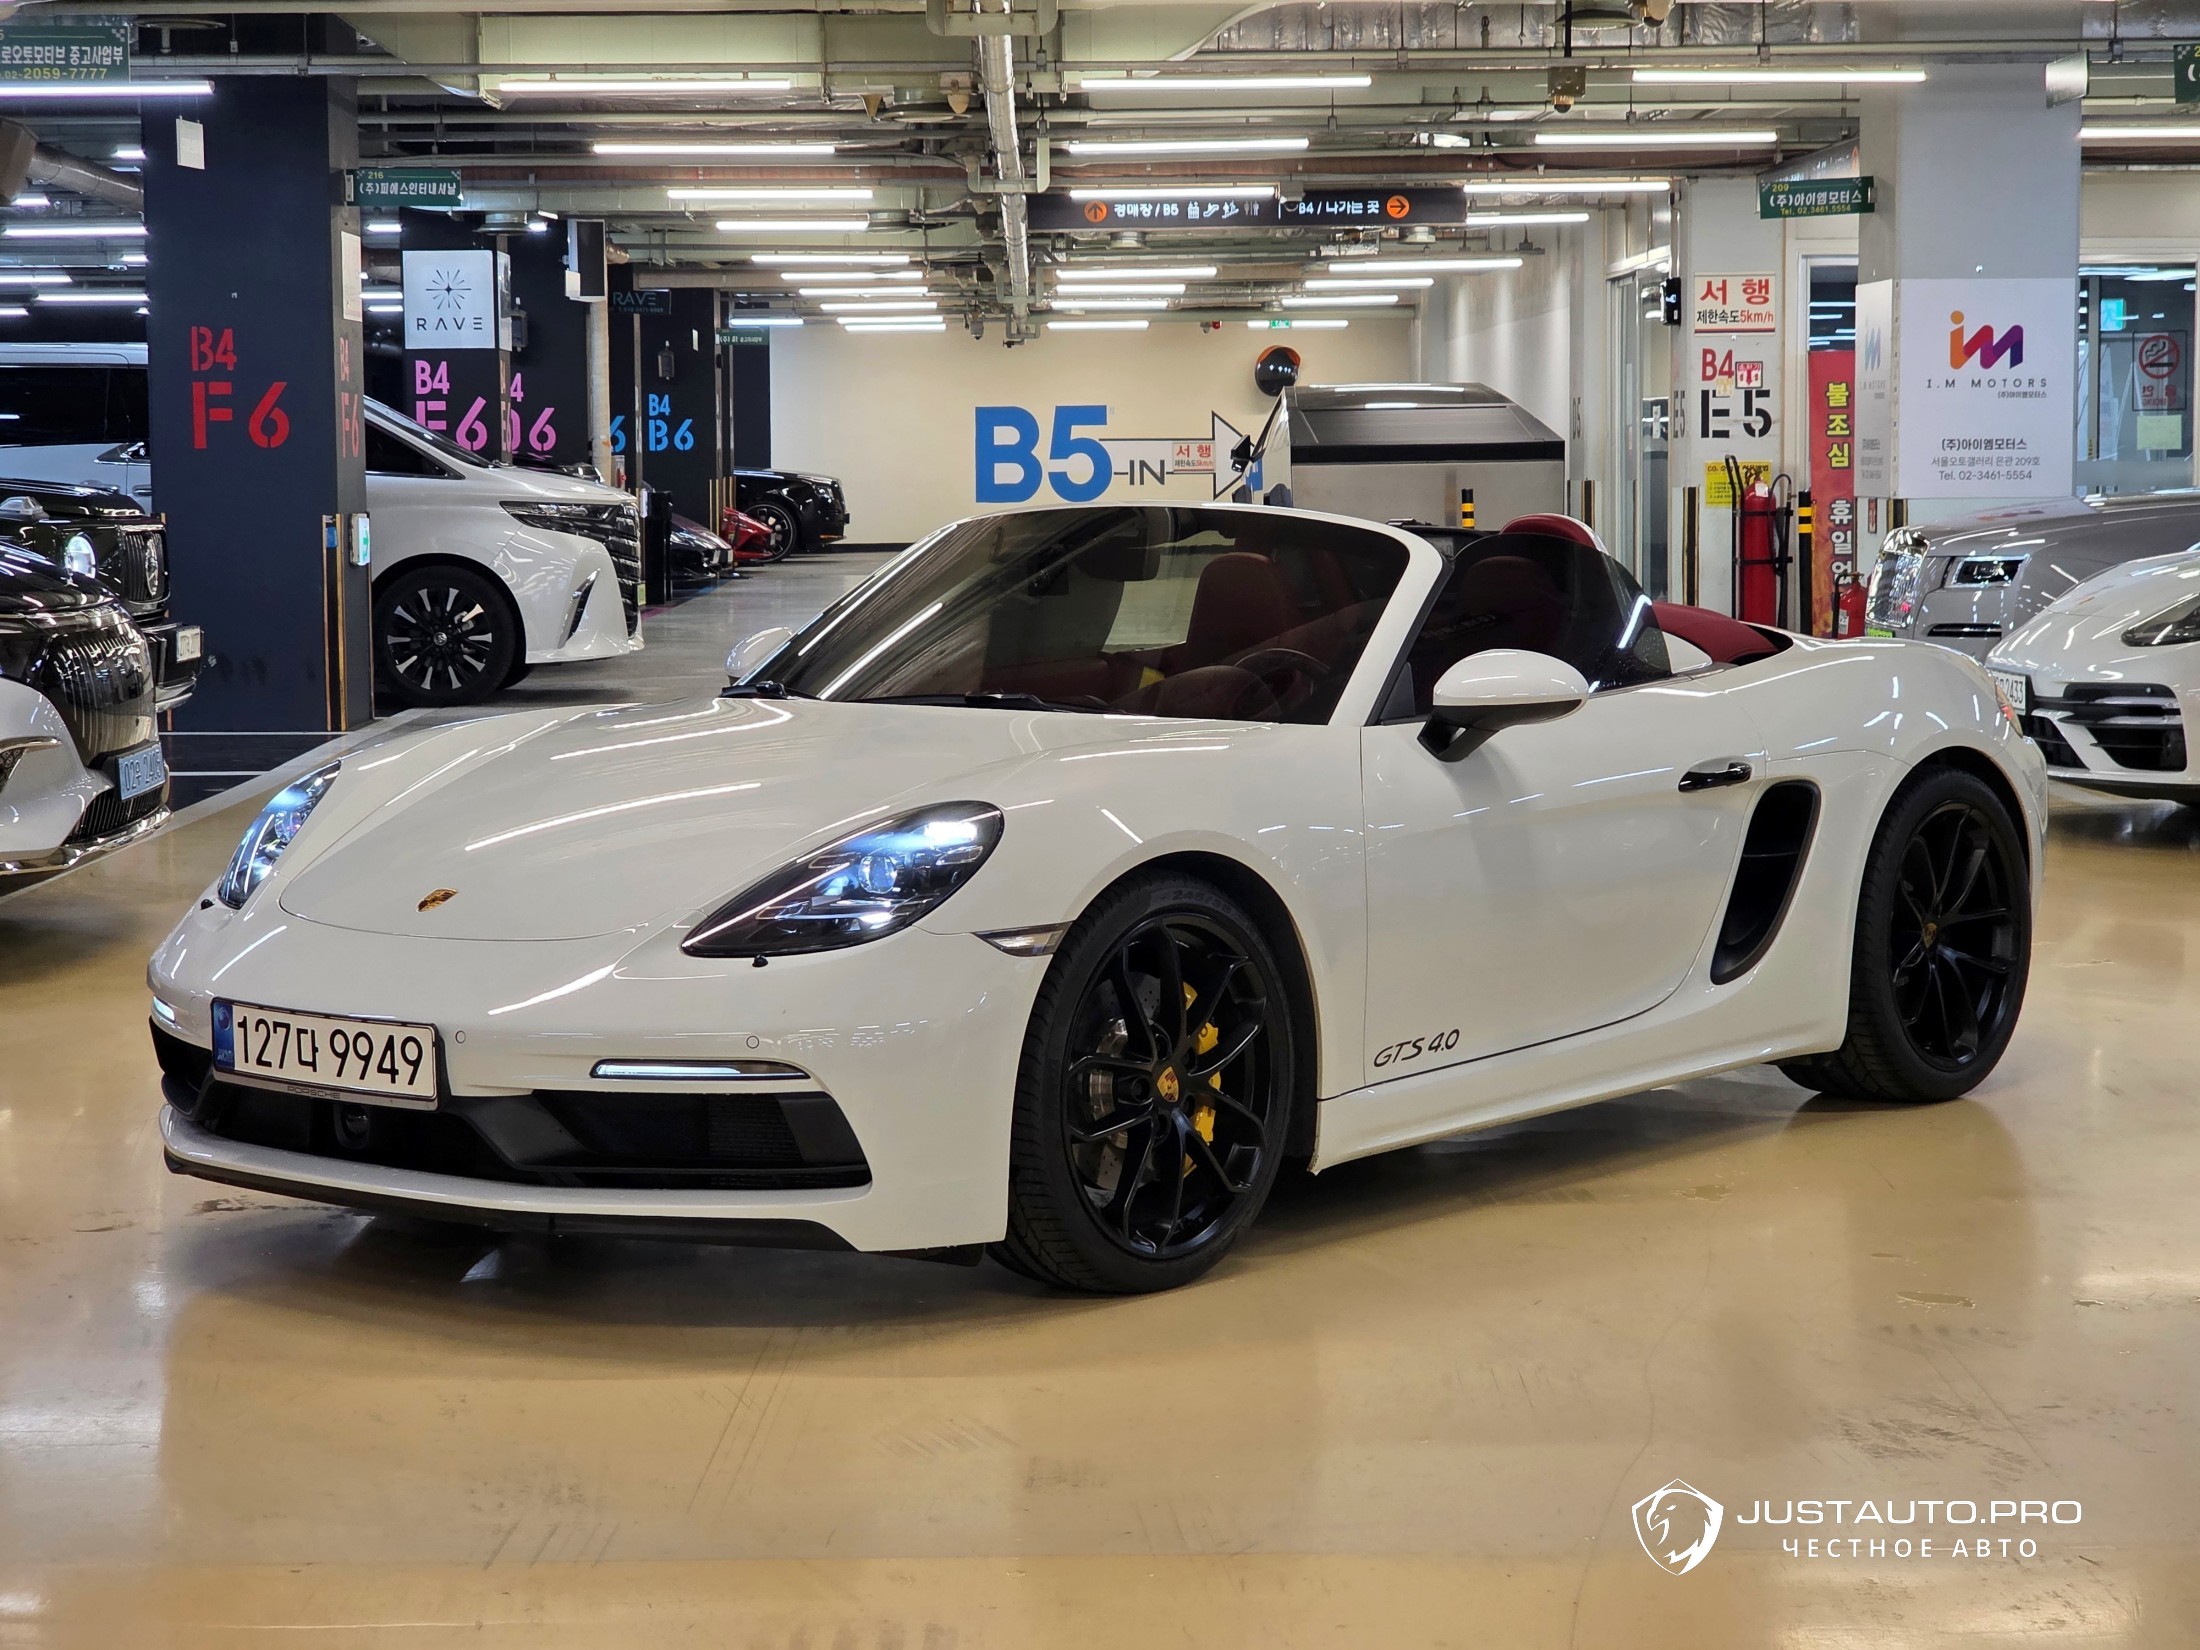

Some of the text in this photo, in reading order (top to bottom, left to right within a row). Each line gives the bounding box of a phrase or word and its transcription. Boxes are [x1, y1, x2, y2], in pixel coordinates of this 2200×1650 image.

[70, 46, 123, 65] 중고사업부
[367, 171, 385, 179] 216
[1772, 184, 1789, 192] 209
[1769, 190, 1862, 207] (주)아이엠모터스
[1325, 200, 1363, 215] 나가는
[1367, 200, 1379, 214] 곳
[613, 291, 656, 306] RAVE
[416, 317, 483, 331] RAVE
[191, 326, 237, 371] B4
[1702, 347, 1735, 382] B4
[415, 360, 450, 395] B4
[1971, 378, 2048, 389] MOTORS
[648, 393, 671, 417] B4
[1941, 438, 2027, 451] (주)아이엠모터스
[975, 404, 1113, 503] B5
[1931, 455, 1993, 467] 서울오토갤러리
[2015, 455, 2040, 467] 209호
[1938, 470, 2032, 481] Tel. 02-3461-5554
[1373, 1028, 1460, 1068] GTS 4.0
[328, 1028, 424, 1086] 9949
[287, 1085, 341, 1099] PORSCHE
